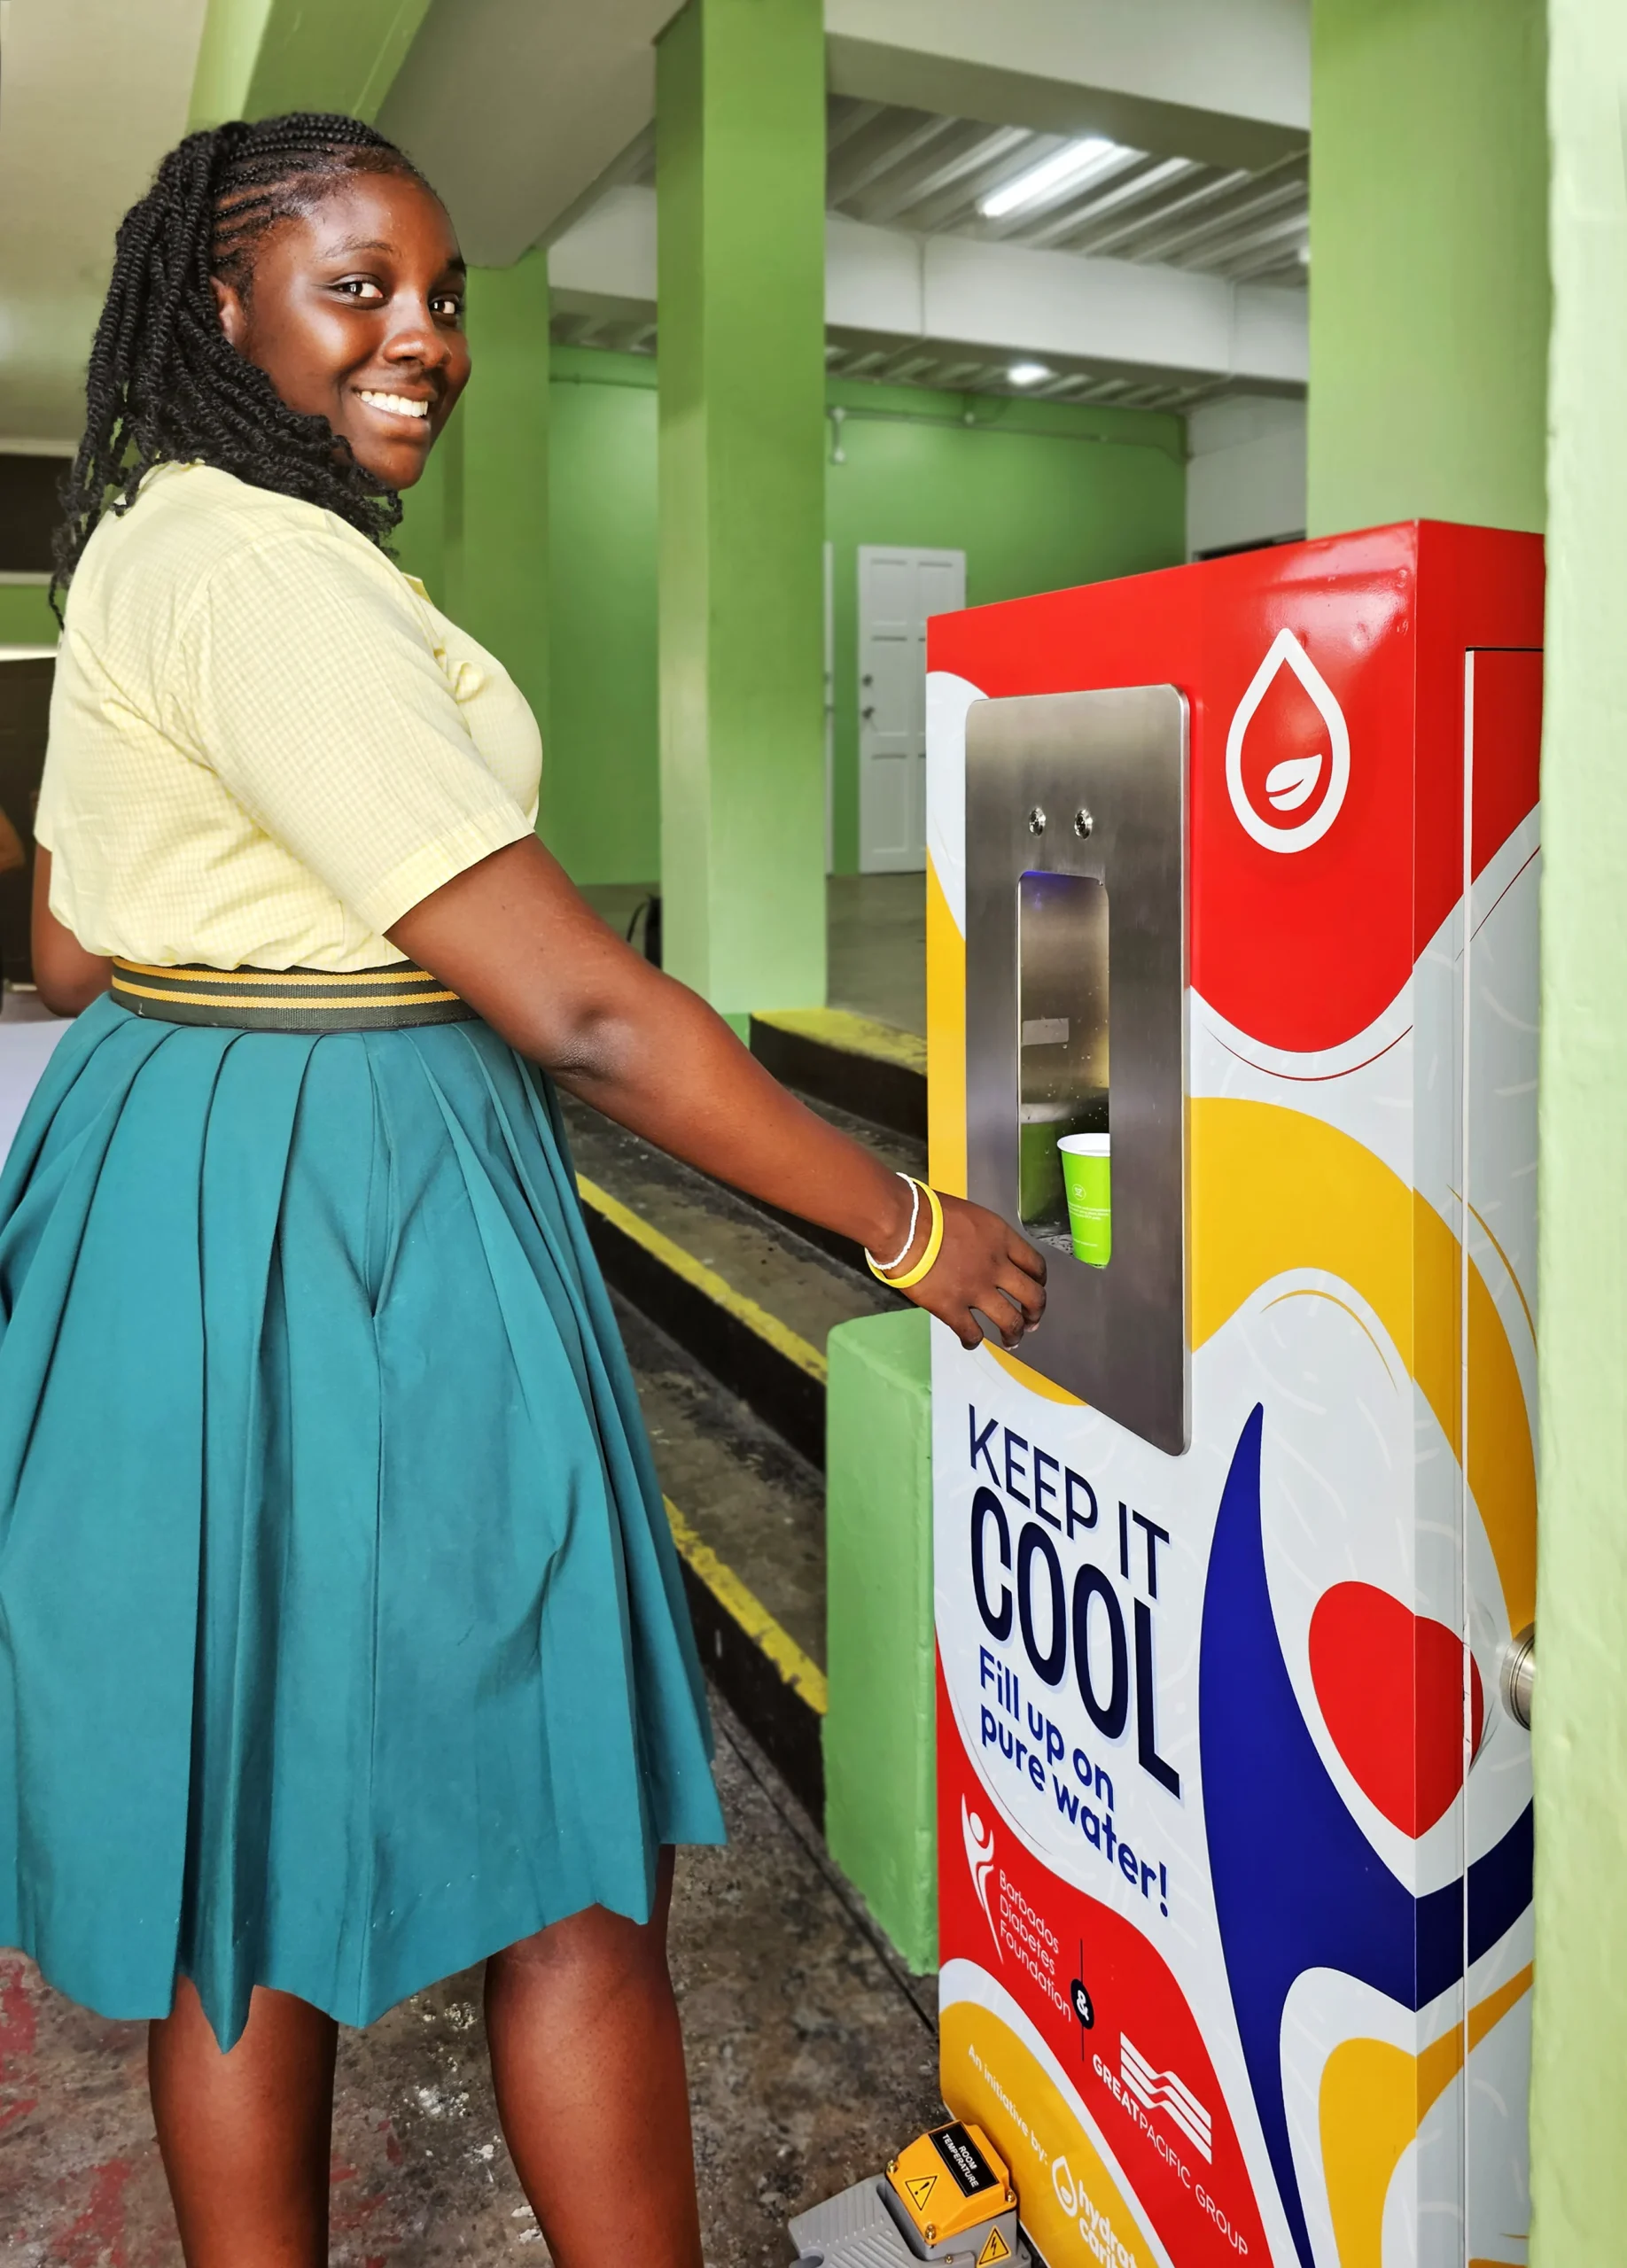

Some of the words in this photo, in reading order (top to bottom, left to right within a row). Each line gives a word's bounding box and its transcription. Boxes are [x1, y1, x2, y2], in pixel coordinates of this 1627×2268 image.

[969, 1403, 1098, 1540] KEEP
[1118, 1501, 1169, 1598] IT
[971, 1486, 1180, 1799] COOL
[980, 1644, 1019, 1721] Fill
[1028, 1701, 1064, 1766] up
[1073, 1748, 1114, 1812] on
[981, 1704, 1046, 1791] pure
[1053, 1773, 1168, 1917] water!
[1000, 1868, 1059, 1954] Barbados
[1000, 1894, 1055, 1976] Diabetes
[1000, 1919, 1071, 2023] Foundation
[1077, 1989, 1089, 2021] &
[969, 2044, 982, 2071] An
[985, 2063, 1028, 2137] initiative
[1031, 2129, 1047, 2165] by:
[942, 2132, 979, 2188] TEMPERATURE
[958, 2145, 977, 2170] ROOM
[1195, 2184, 1248, 2255] GROUP
